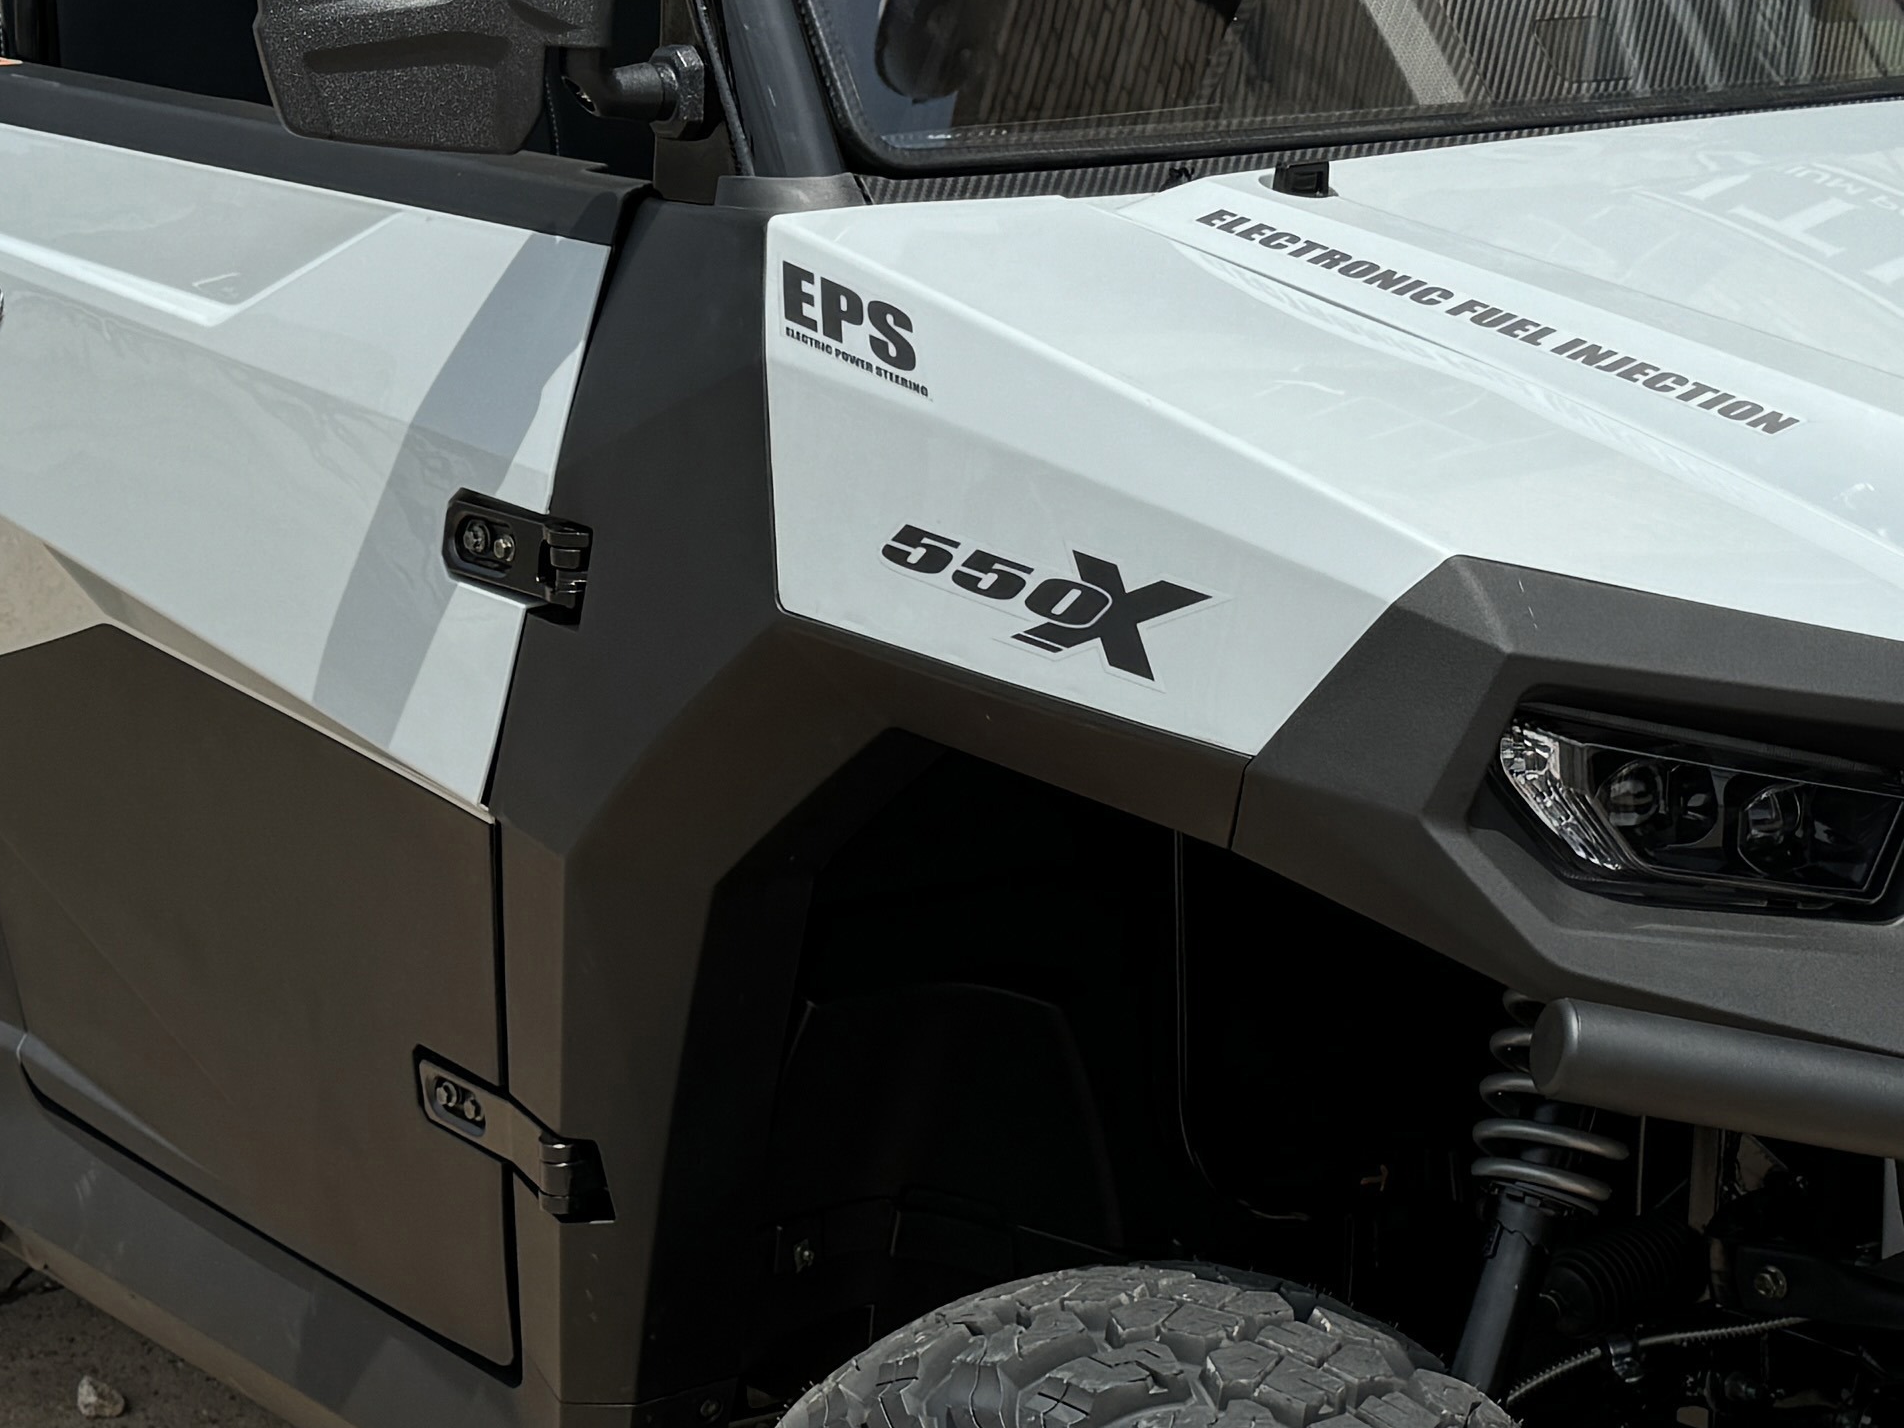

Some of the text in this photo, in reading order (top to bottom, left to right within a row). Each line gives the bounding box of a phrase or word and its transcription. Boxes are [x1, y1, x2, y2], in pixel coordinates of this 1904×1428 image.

[782, 260, 917, 372] EPS
[785, 326, 930, 398] ELECTRIC POWER STEERING
[1195, 208, 1802, 437] ELECTRONIC FUEL INJECTION
